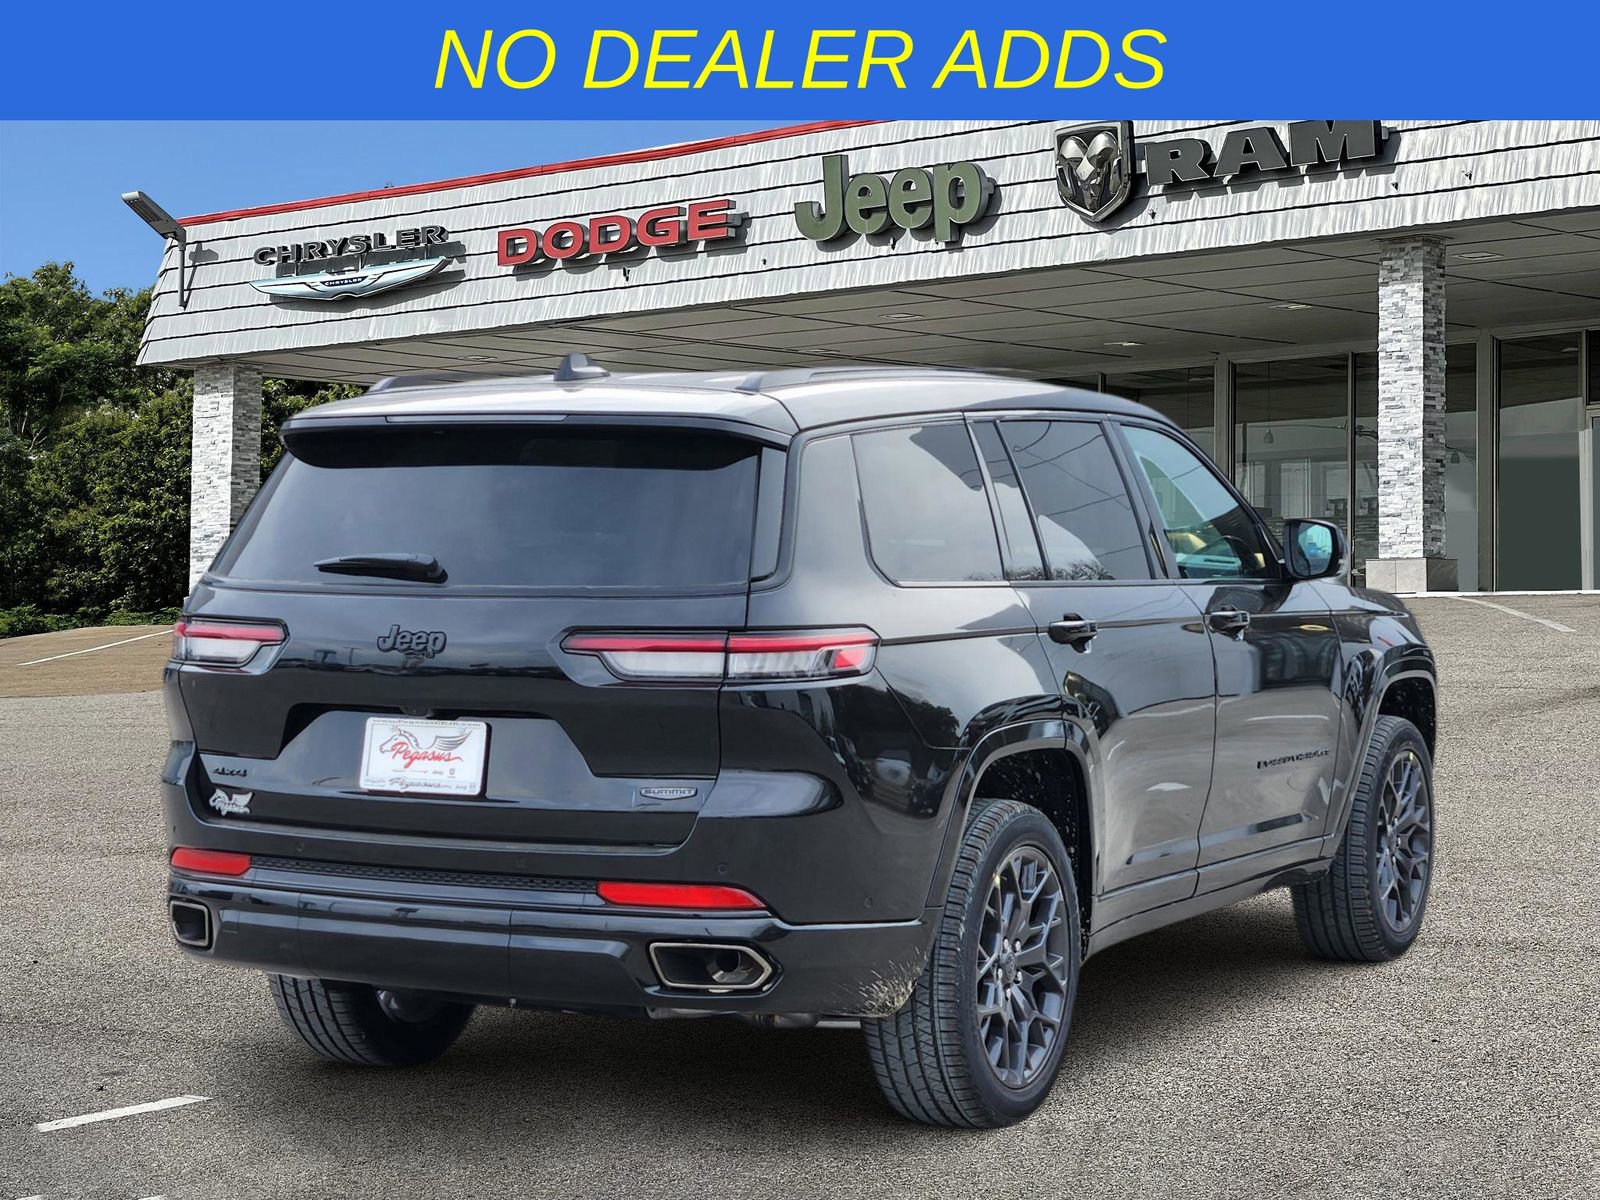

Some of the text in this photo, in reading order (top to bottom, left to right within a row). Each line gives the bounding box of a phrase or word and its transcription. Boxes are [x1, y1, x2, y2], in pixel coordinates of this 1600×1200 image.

[1144, 119, 1384, 187] RAM
[794, 154, 990, 243] Jeep
[253, 225, 449, 267] CHRYSLER
[497, 199, 736, 267] DODGE
[325, 277, 363, 286] CHRYSLER
[377, 624, 447, 659] Jeep
[391, 741, 464, 769] Pegasus
